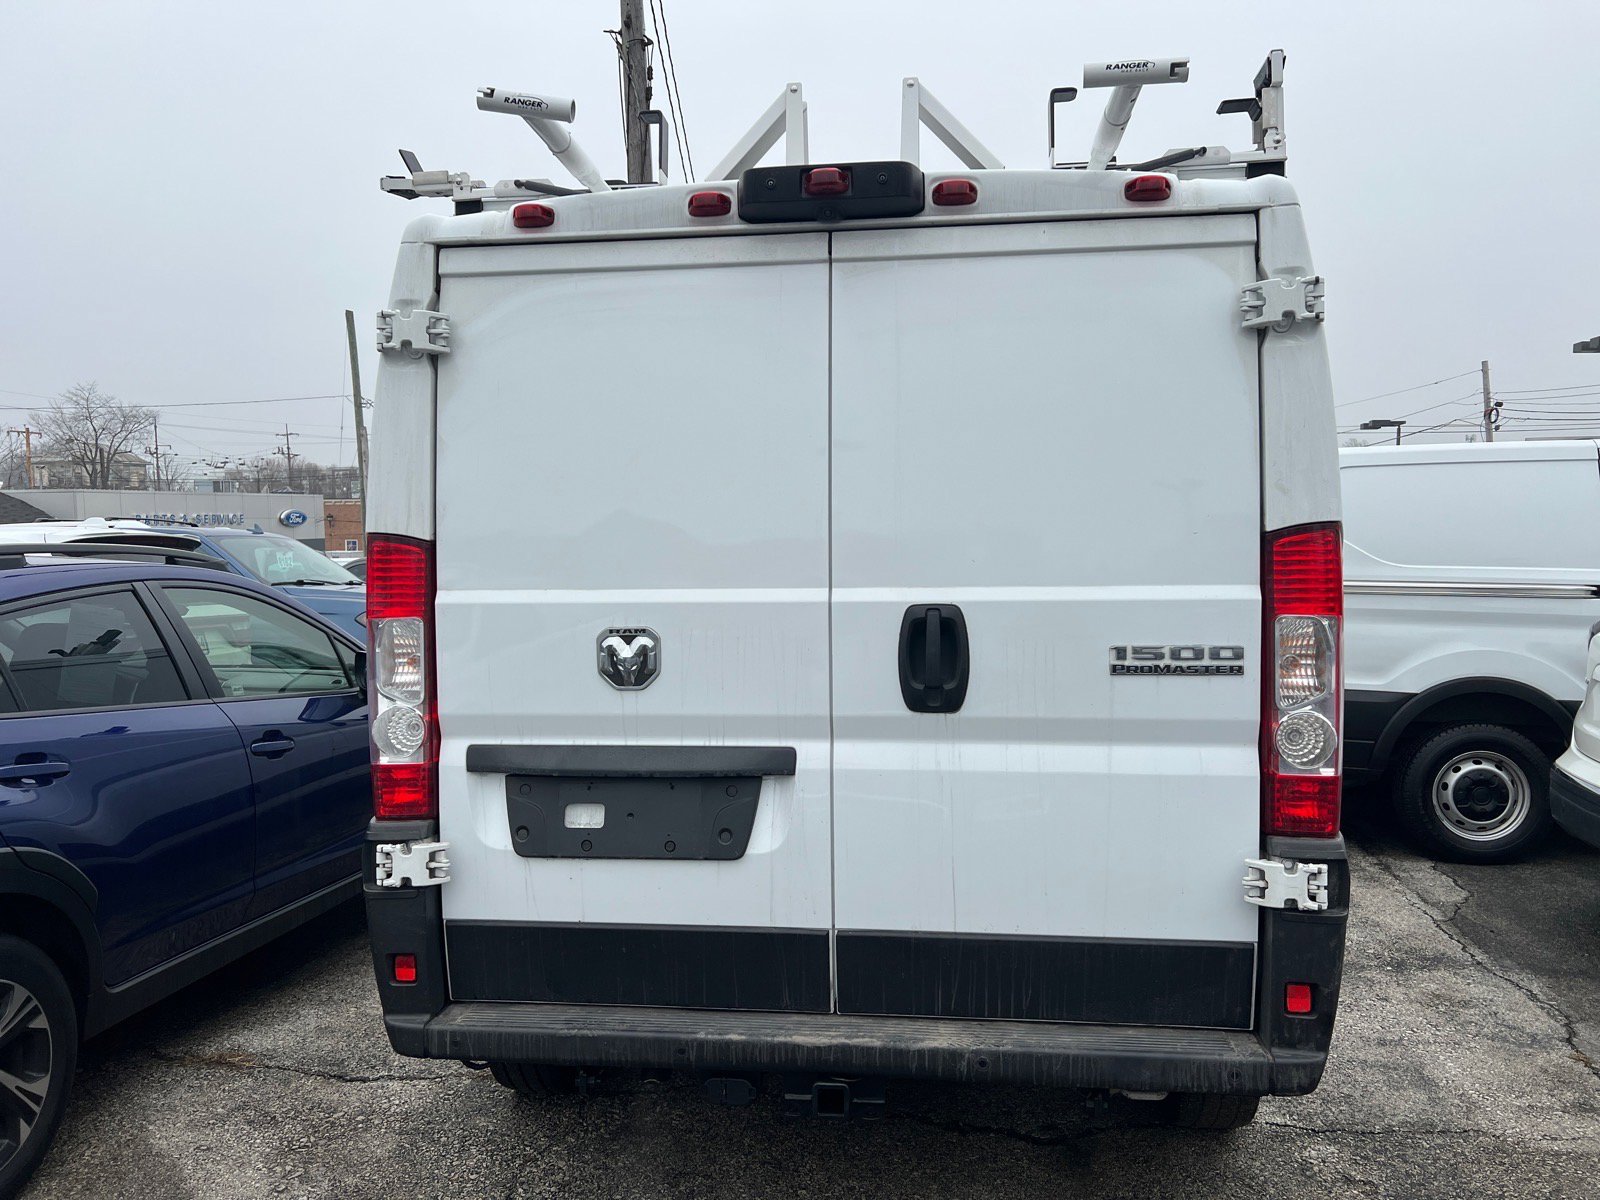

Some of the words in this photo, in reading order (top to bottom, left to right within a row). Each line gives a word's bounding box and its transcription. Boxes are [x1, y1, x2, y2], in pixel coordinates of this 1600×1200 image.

[1105, 62, 1149, 71] RANGER
[503, 96, 543, 108] RANGER
[135, 514, 177, 525] PARTS
[195, 514, 245, 525] SERVICE
[289, 512, 304, 523] Ford
[1109, 645, 1244, 660] 1500
